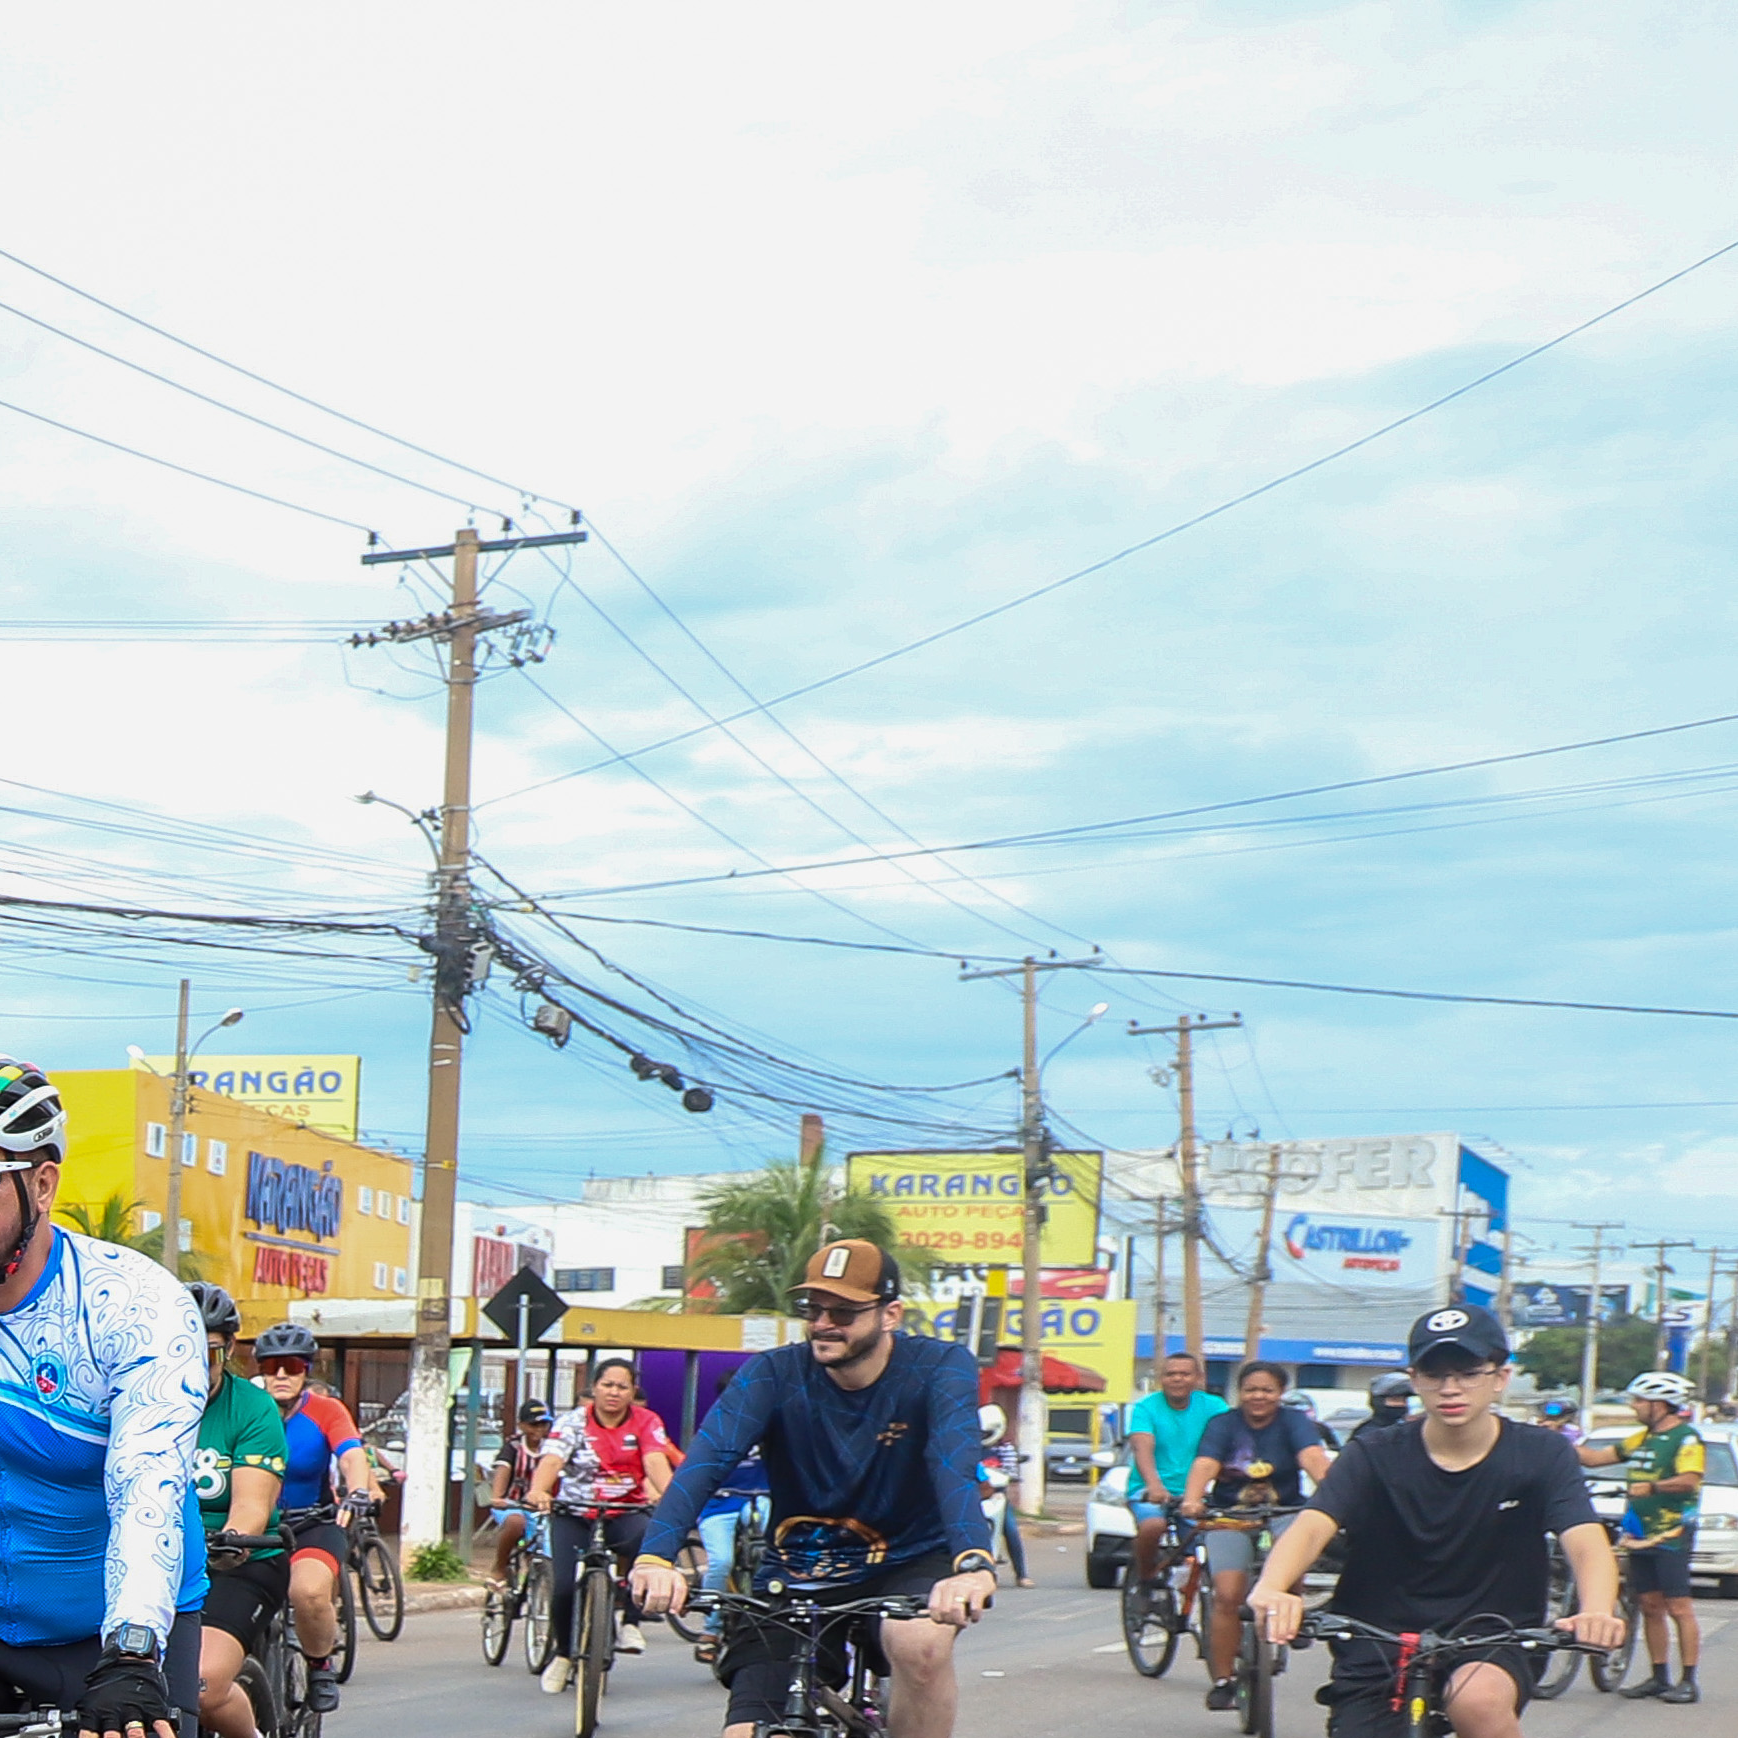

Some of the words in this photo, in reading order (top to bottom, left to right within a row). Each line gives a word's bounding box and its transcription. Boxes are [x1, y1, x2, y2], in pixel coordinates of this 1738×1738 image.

[167, 1066, 342, 1095] RANGÃO
[869, 1173, 1073, 1197] KARANGO
[897, 1204, 959, 1218] AUTO
[966, 1204, 1024, 1220] PEÇA
[898, 1231, 1024, 1250] 3029-894
